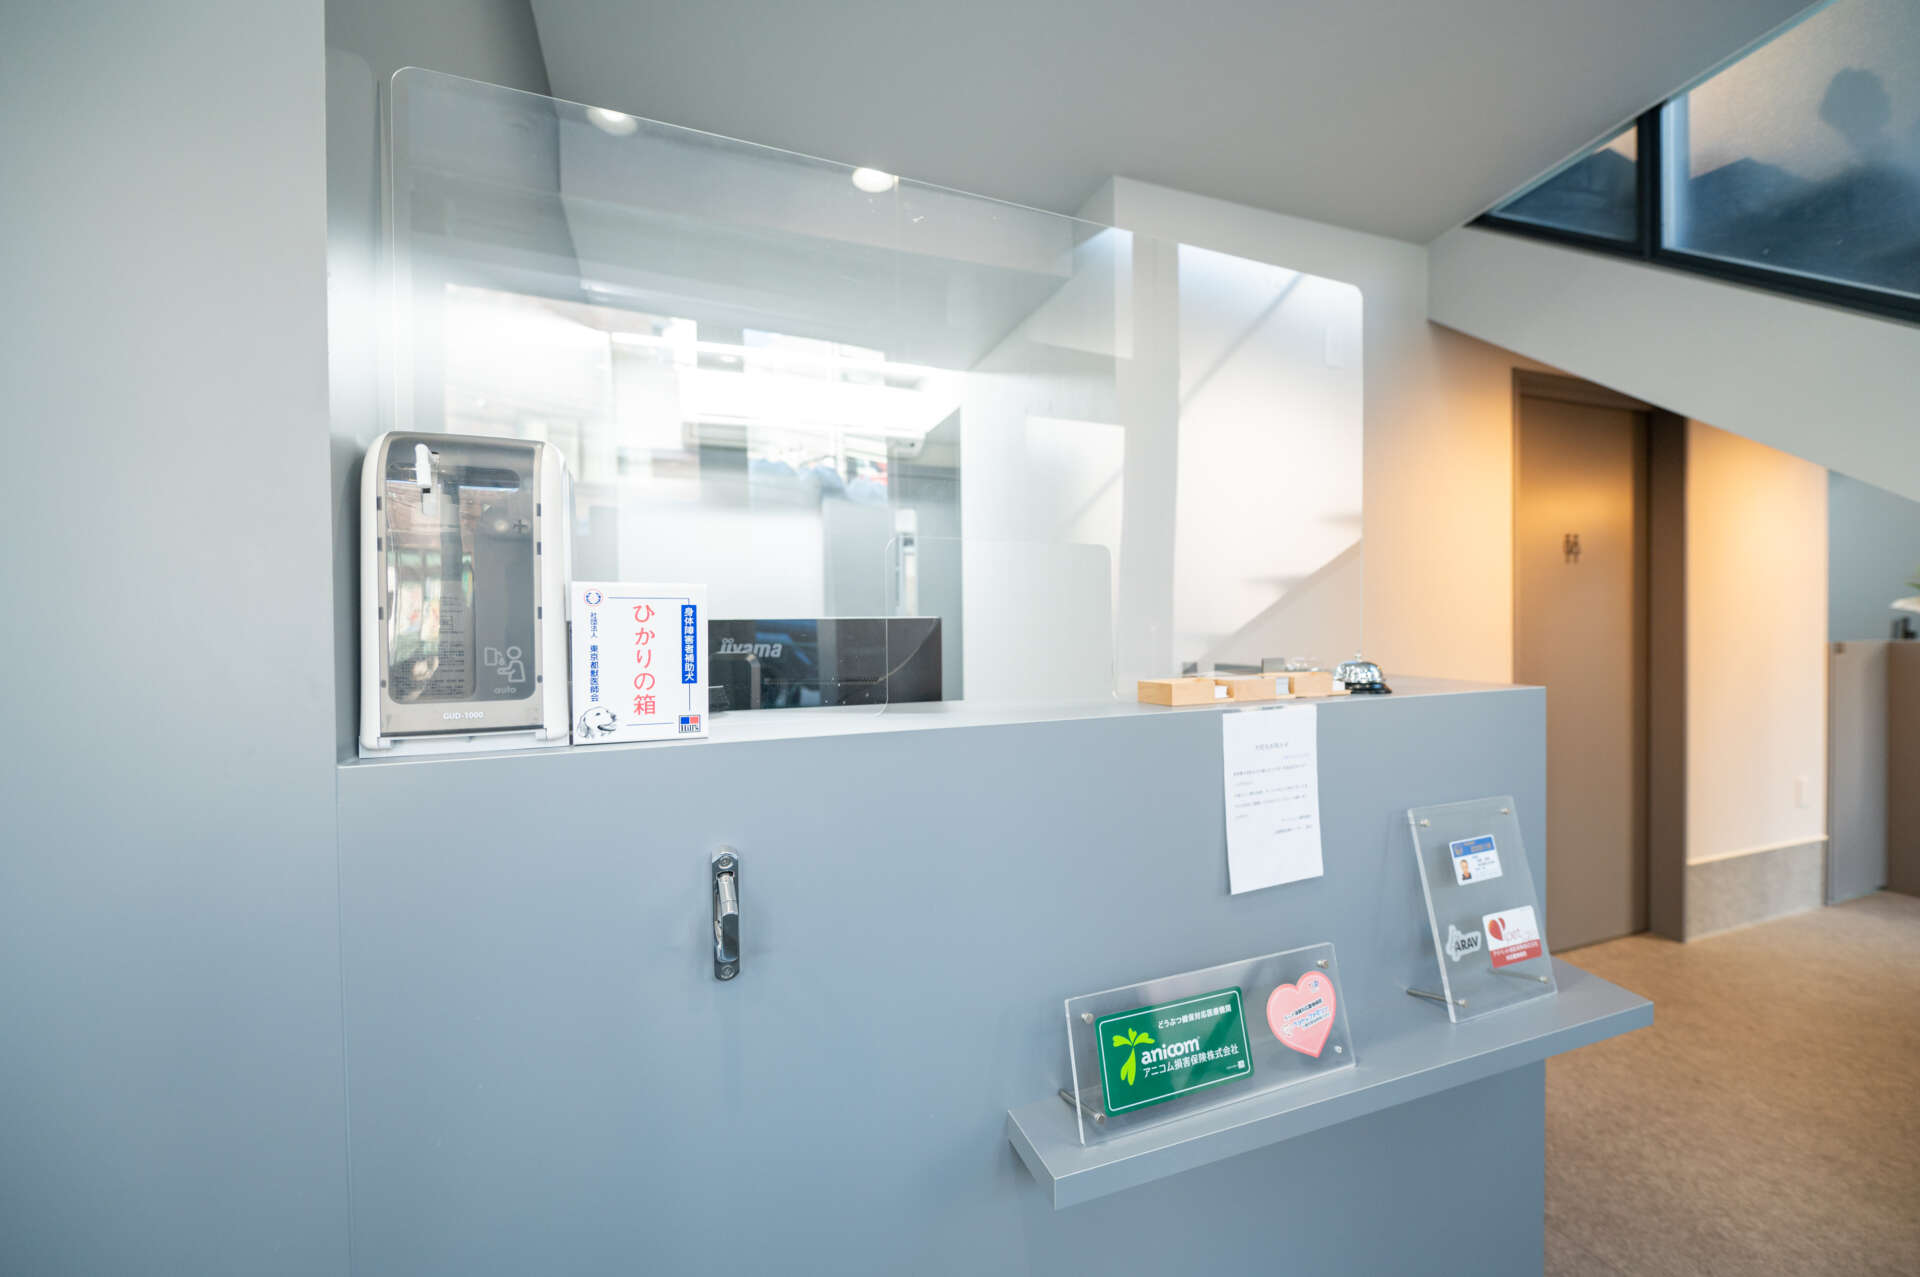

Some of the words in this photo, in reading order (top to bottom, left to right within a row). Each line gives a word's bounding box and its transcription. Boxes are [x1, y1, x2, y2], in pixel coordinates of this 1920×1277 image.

[590, 611, 598, 639] 社団法人
[683, 607, 695, 682] 身体障害者補助犬
[590, 645, 599, 703] 東京都獣医師会
[633, 604, 656, 716] ひかりの箱
[494, 686, 517, 695] auto
[443, 711, 484, 720] GUD-1000
[1455, 936, 1479, 952] ARAV
[1141, 1038, 1200, 1065] anicom
[1143, 1044, 1240, 1078] アニコム損害保険株式会社
